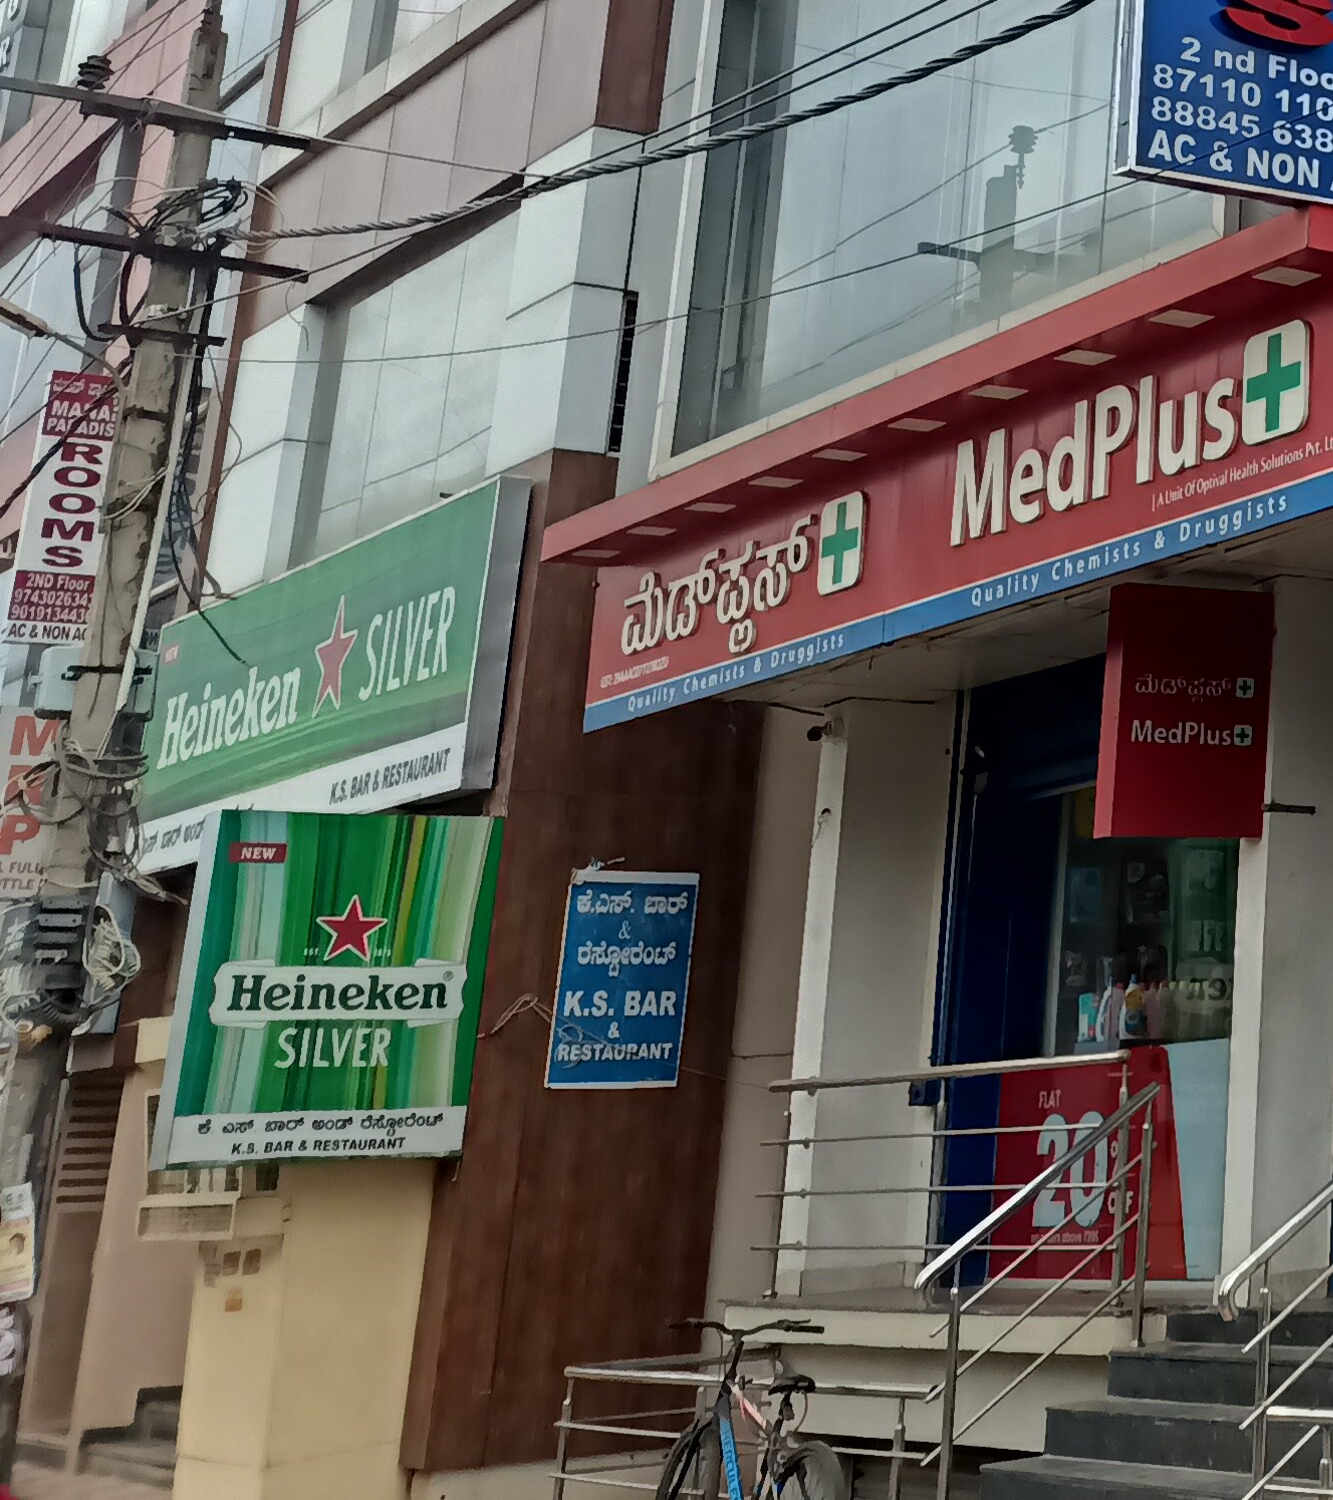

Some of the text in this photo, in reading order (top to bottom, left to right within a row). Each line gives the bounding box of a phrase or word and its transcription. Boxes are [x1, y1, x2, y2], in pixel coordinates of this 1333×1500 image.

[1181, 36, 1201, 62] 2
[1214, 49, 1255, 75] nd
[1153, 63, 1262, 107] 87110
[1151, 96, 1261, 139] 88845
[1148, 130, 1197, 166] AC
[1209, 140, 1233, 172] &
[1247, 147, 1320, 188] NON
[51, 400, 117, 422] MANA
[46, 417, 115, 437] PAADIS
[950, 375, 1239, 548] MedPlus
[1165, 487, 1184, 505] Unit
[1185, 479, 1196, 498] Of
[1196, 468, 1228, 495] Optival
[1229, 461, 1260, 483] Health
[1260, 447, 1304, 472] Solutions
[1305, 442, 1323, 457] Pvt.
[41, 441, 104, 568] ROOMS
[971, 494, 1288, 607] Quality Chemists & Druggists
[25, 572, 90, 591] 2ND Floor
[14, 588, 94, 608] 974302634
[10, 604, 90, 624] 901913443
[8, 622, 27, 638] AC
[29, 624, 38, 639] &
[42, 625, 71, 642] NON
[358, 586, 456, 702] SILVER
[627, 682, 677, 712] Quality
[683, 663, 746, 695] Chemists
[753, 658, 762, 674] &
[770, 632, 845, 669] Druggists
[156, 666, 301, 771] Heineken
[1130, 719, 1232, 746] MedPlus
[328, 747, 452, 805] K.S. BAR & RESTAURANT
[240, 846, 277, 861] NEW
[0, 877, 36, 891] TTLE
[643, 890, 689, 915] ಬಾರ್
[618, 920, 632, 940] &
[227, 974, 448, 1012] Heineken
[563, 990, 677, 1018] K.S. BAR
[607, 1021, 621, 1039] &
[274, 1027, 392, 1070] SILVER
[557, 1042, 674, 1063] RESTAURANT
[1038, 1089, 1062, 1110] FLAT
[231, 1136, 407, 1156] K.S. BAR & RESTAURANT
[1032, 1111, 1108, 1229] 20
[1107, 1190, 1134, 1216] OF
